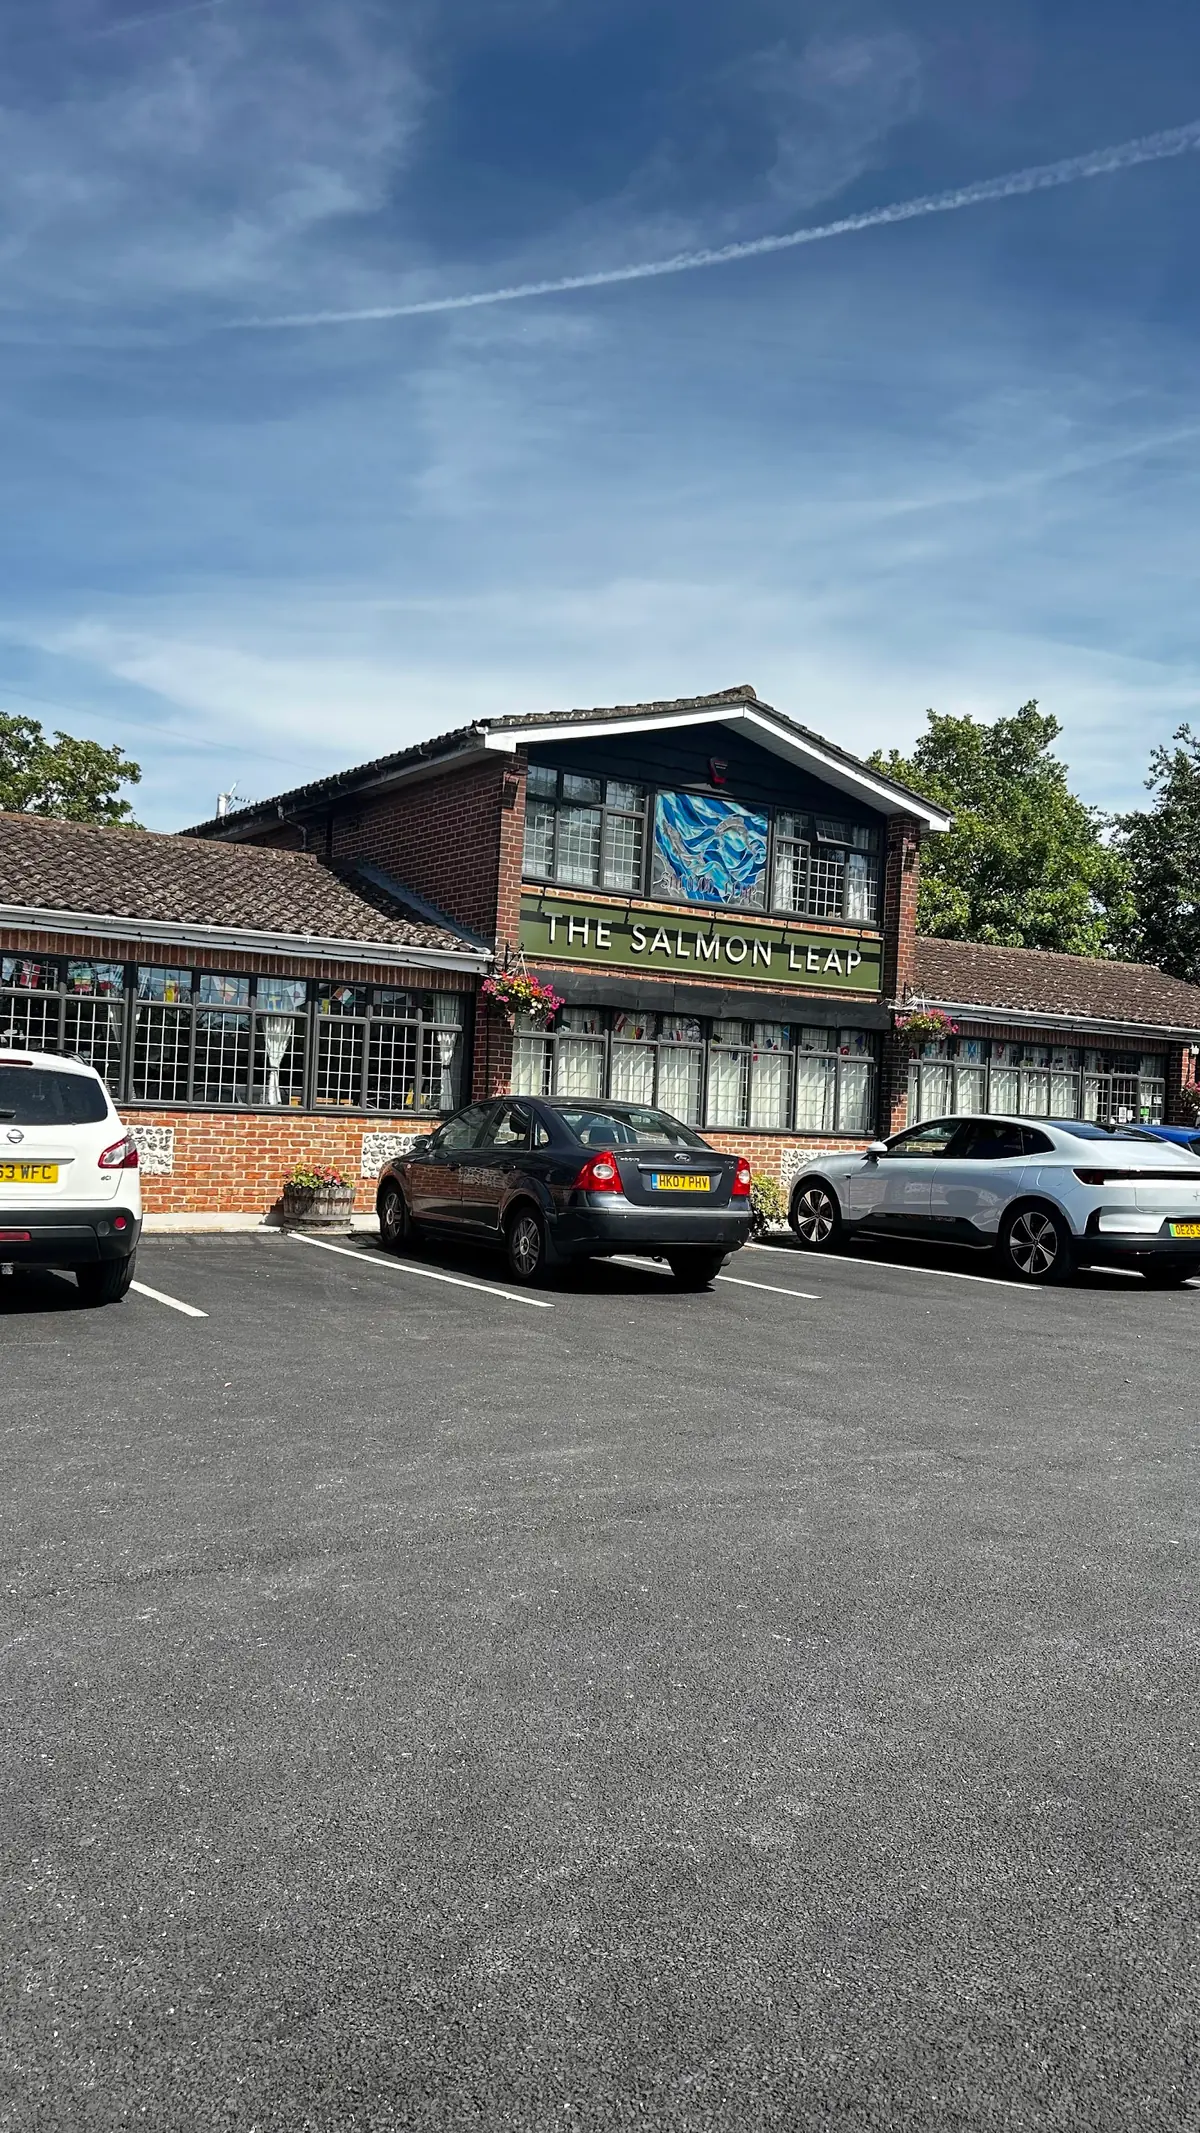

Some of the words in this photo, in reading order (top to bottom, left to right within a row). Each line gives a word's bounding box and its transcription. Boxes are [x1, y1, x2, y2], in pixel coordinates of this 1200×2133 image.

[543, 911, 614, 947] THE
[630, 923, 772, 966] SALMON
[788, 942, 862, 975] LEAP
[20, 1164, 52, 1180] WFC
[659, 1174, 686, 1187] HK07
[688, 1176, 708, 1189] PHV
